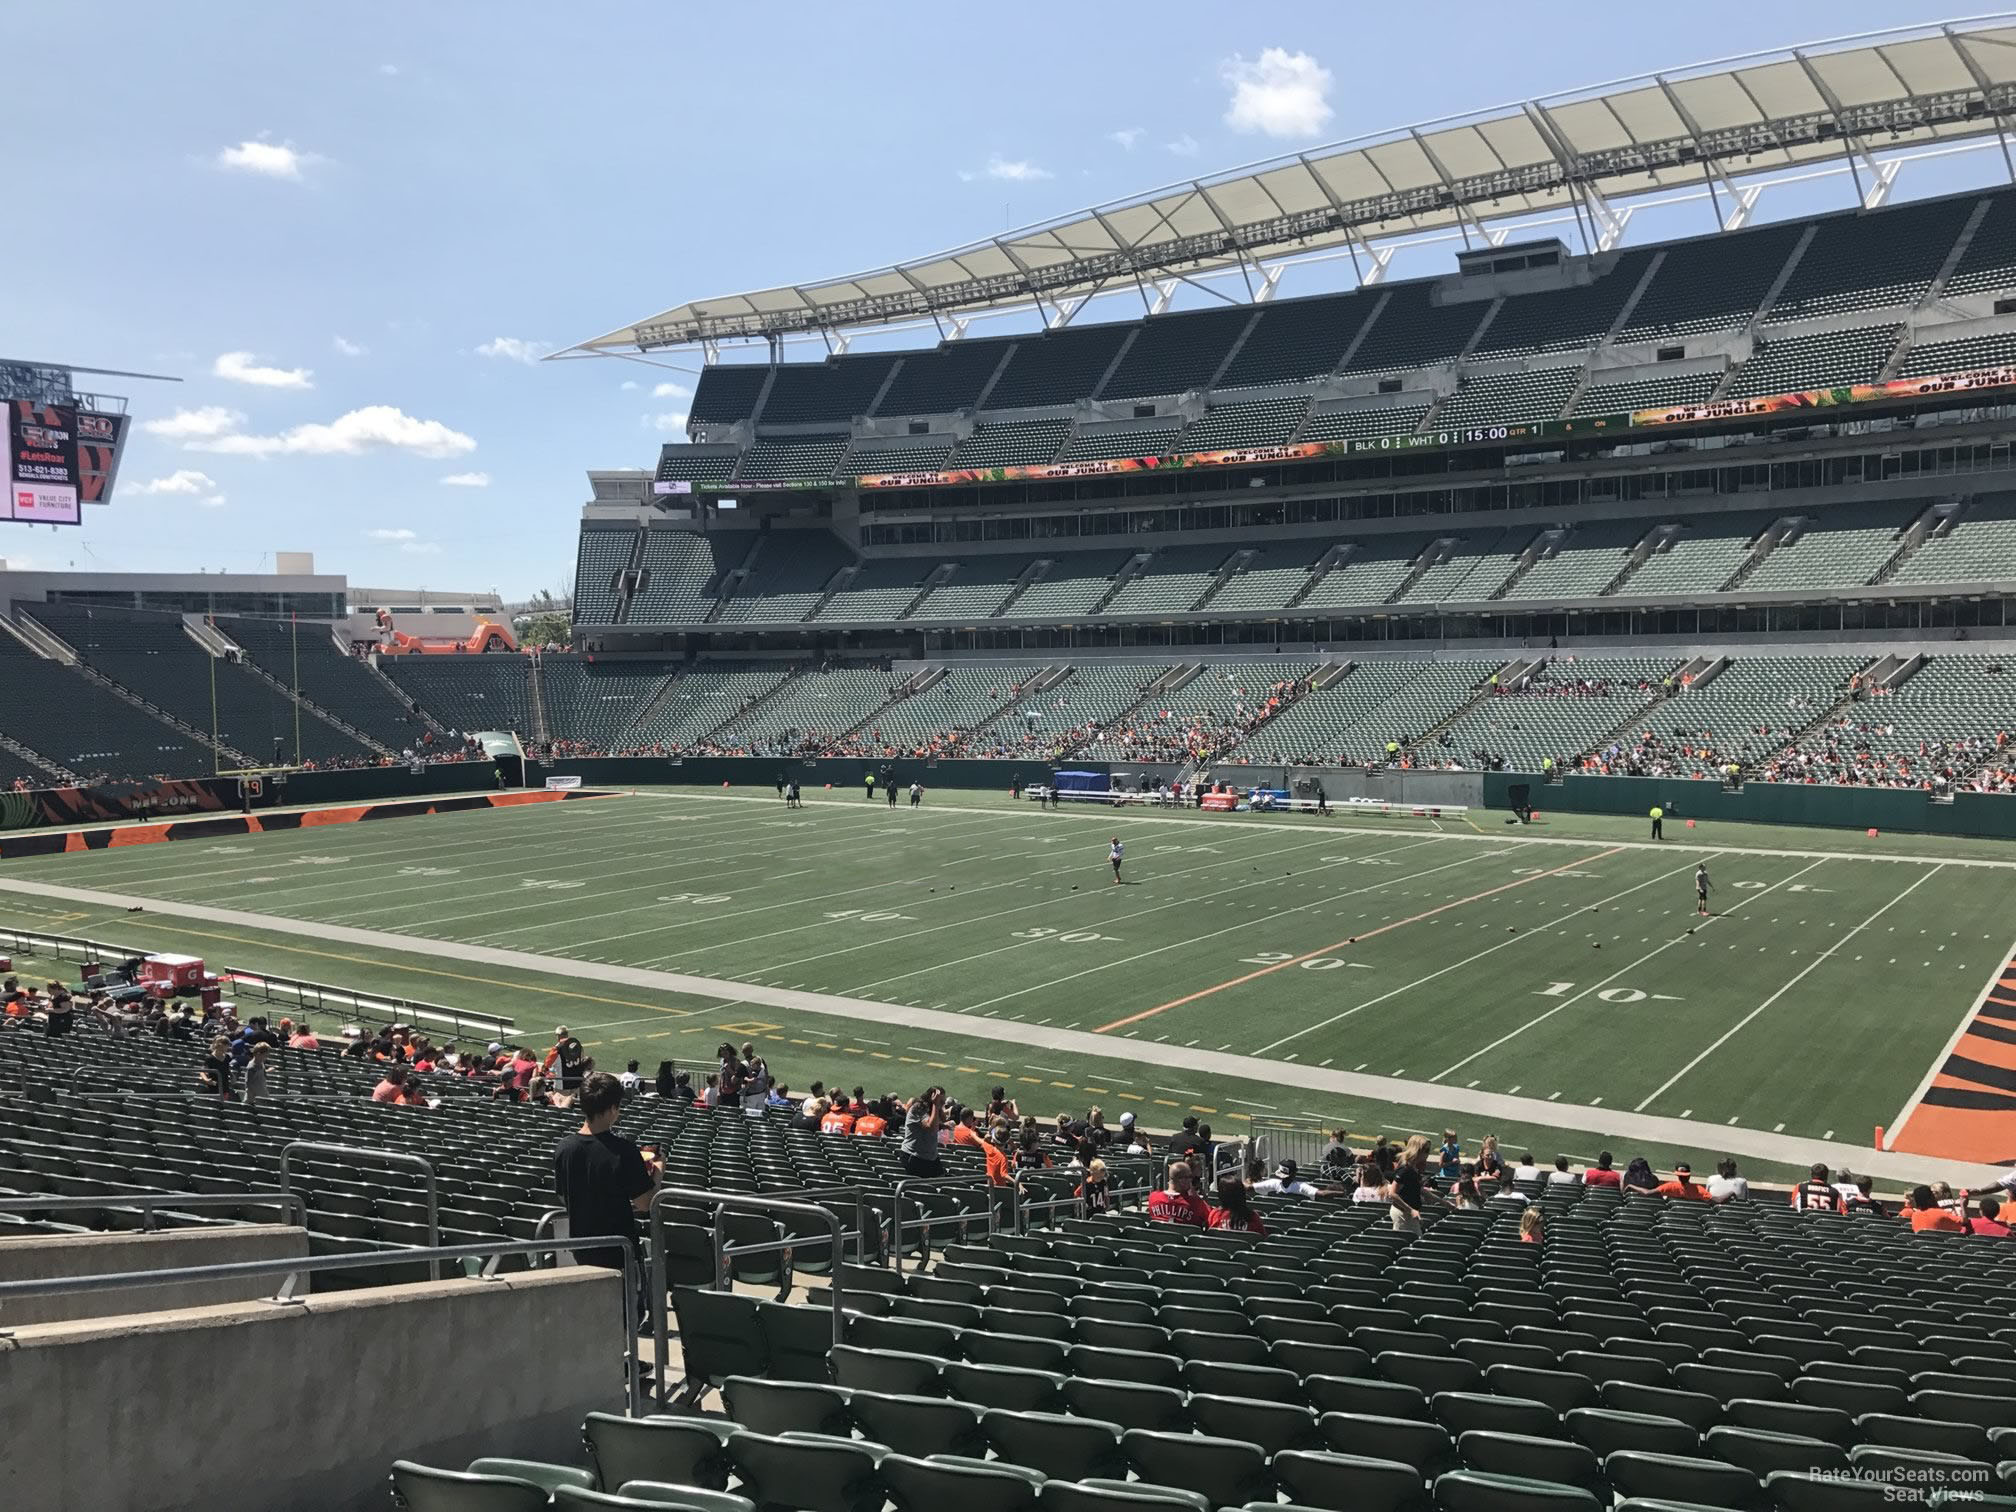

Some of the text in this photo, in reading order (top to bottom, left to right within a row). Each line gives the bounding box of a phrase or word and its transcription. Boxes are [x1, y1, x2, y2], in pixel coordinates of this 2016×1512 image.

[1919, 375, 2016, 393] OUR JUNG
[1940, 371, 1998, 382] WELCOME
[1665, 404, 1767, 421] OUR JUNGLE
[1683, 402, 1732, 413] WELCOME
[1355, 441, 1375, 450] BLK
[1381, 438, 1390, 449] 0
[1408, 435, 1434, 446] WHT
[1439, 433, 1448, 444] 0
[1465, 427, 1507, 442] 15:00
[1509, 428, 1527, 436] QTR
[1531, 425, 1537, 434] 1
[1222, 455, 1246, 463] OUR
[823, 909, 900, 922] 40
[1011, 928, 1101, 943] 30
[1237, 952, 1346, 970] 20
[187, 969, 197, 980] G
[1531, 981, 1647, 1003] 10
[1090, 1192, 1105, 1208] 14
[1807, 1193, 1831, 1210] 55
[1151, 1203, 1194, 1221] PHILLIPS
